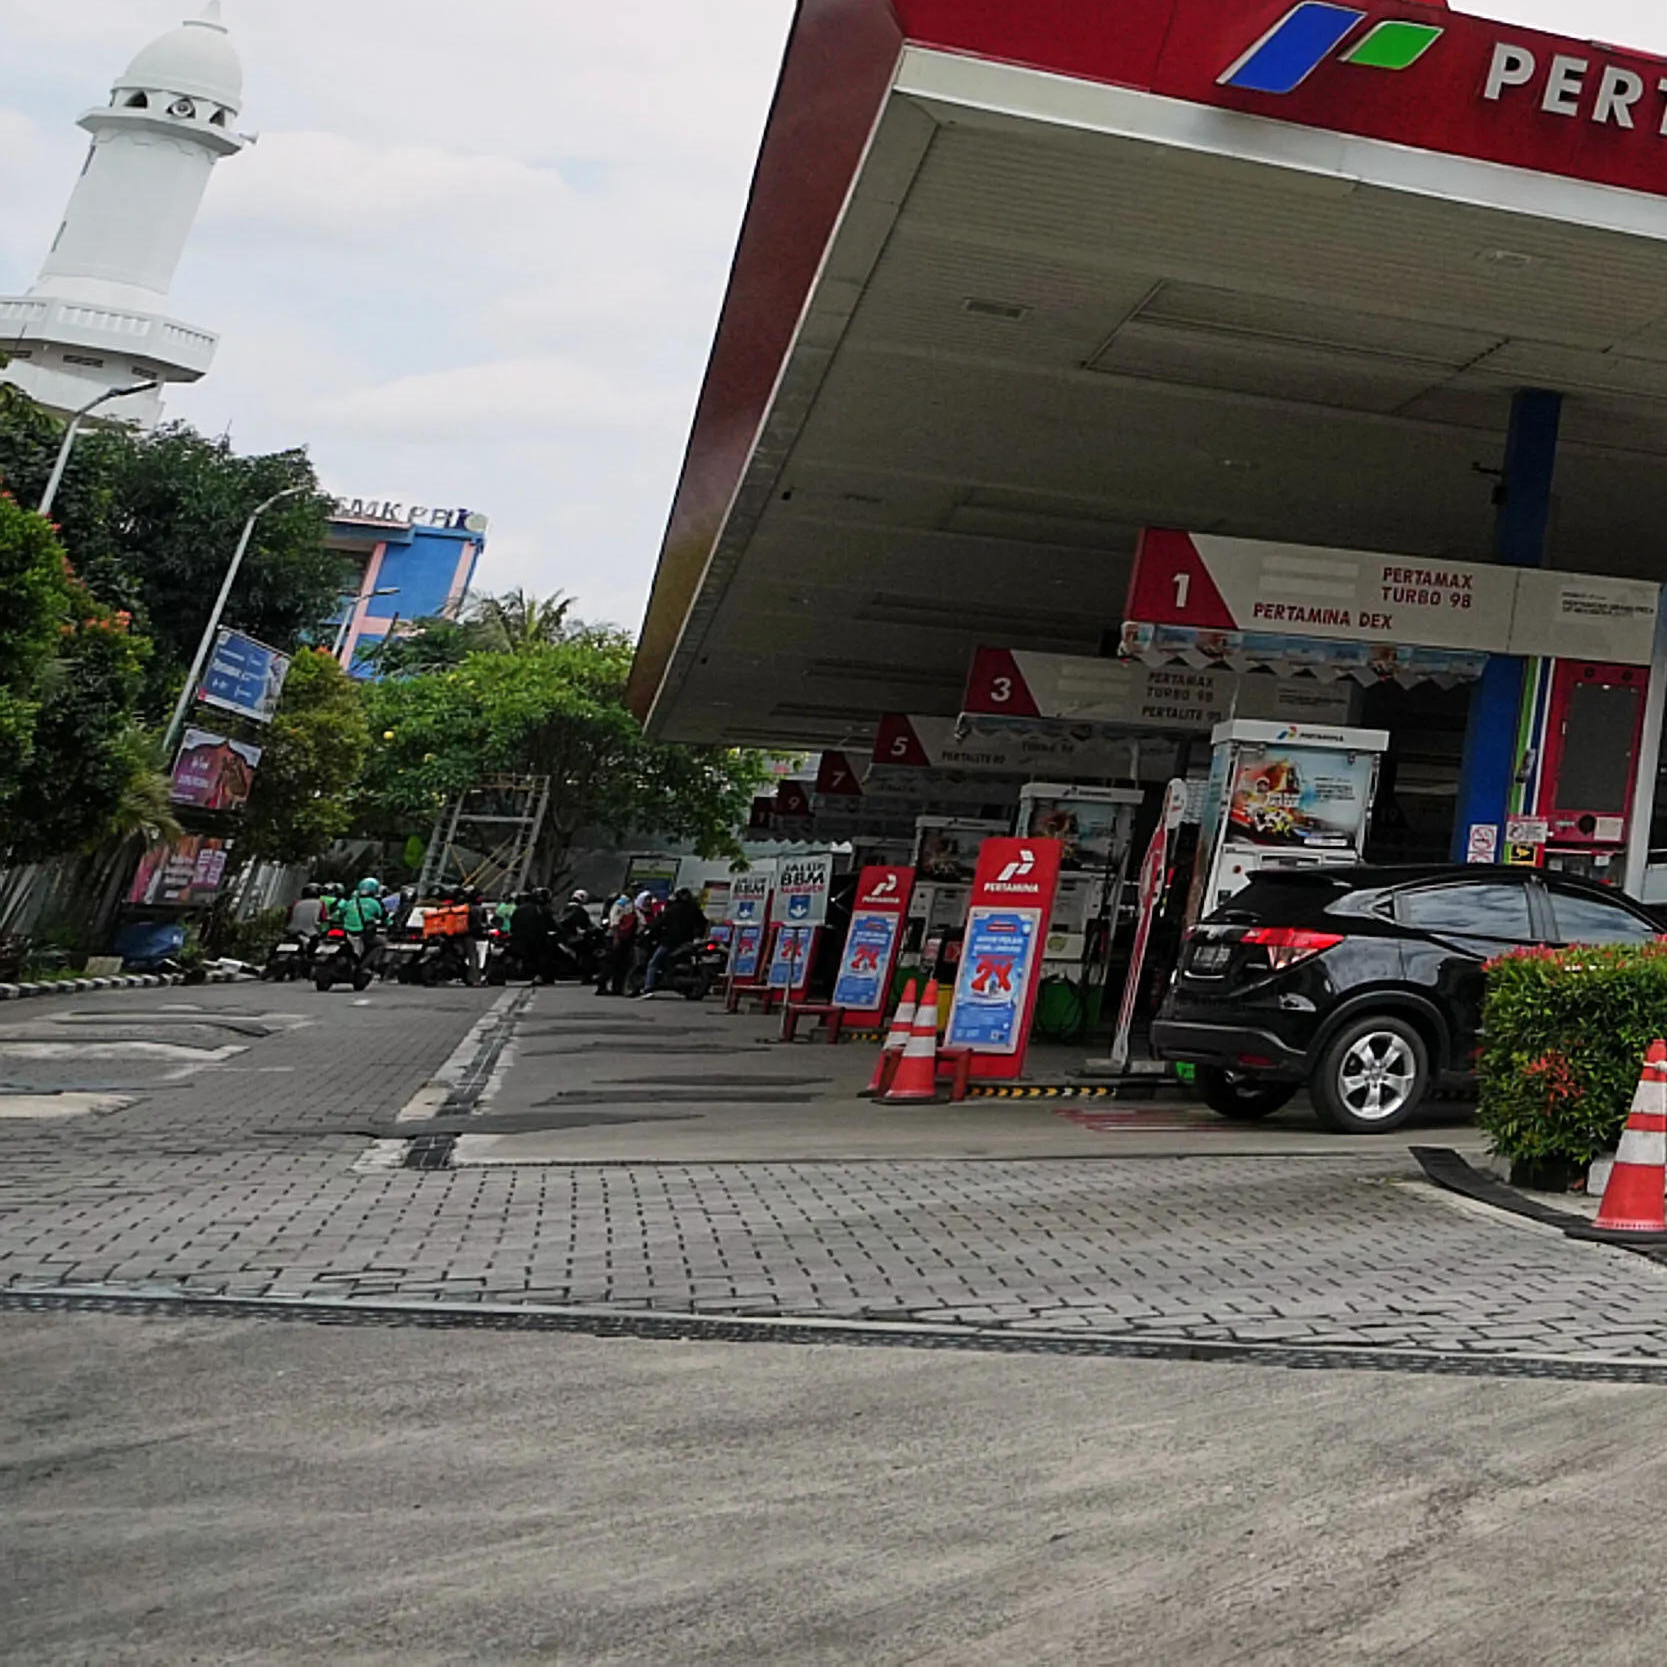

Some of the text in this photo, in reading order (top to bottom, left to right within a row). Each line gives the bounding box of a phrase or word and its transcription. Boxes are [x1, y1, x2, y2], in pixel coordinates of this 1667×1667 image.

[1383, 567, 1473, 590] PERTAMAX
[1171, 573, 1190, 607] 1
[1382, 587, 1472, 608] TURBO 98
[1253, 602, 1393, 629] PERTAMINA DEX
[989, 677, 1012, 702] 3
[1149, 672, 1214, 688] PERTAMAX
[890, 736, 908, 756] 5
[831, 771, 847, 787] 7
[781, 872, 824, 886] BBM
[984, 882, 1039, 893] PERTAMINA
